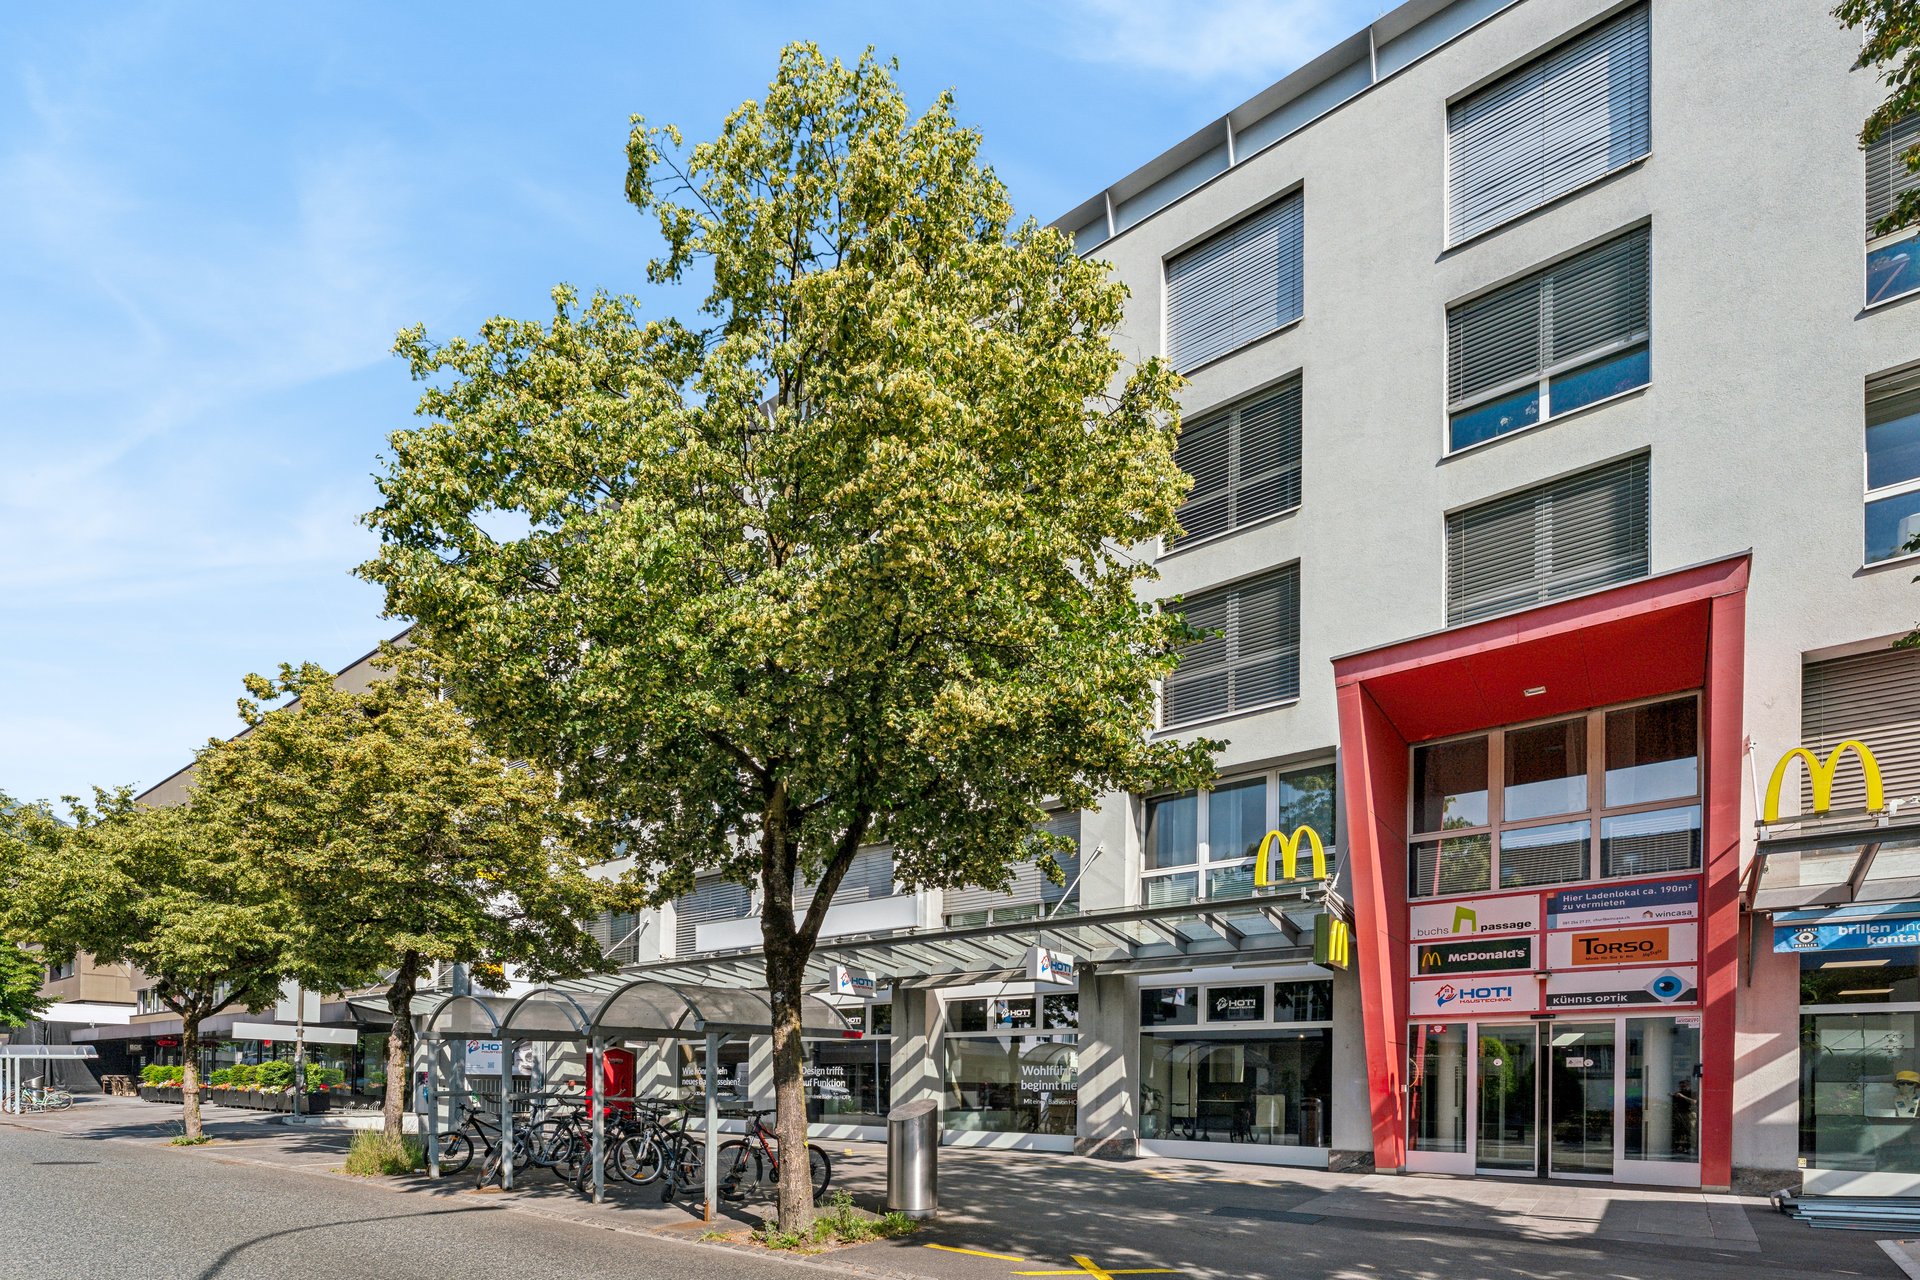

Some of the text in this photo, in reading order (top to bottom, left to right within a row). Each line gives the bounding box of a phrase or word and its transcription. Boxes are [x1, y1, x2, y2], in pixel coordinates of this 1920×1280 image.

[1562, 894, 1583, 902] Hier
[1586, 888, 1640, 900] Ladenlokal
[1642, 887, 1657, 896] ca.
[1562, 900, 1626, 911] zu vermieten
[1655, 909, 1692, 918] wincasa
[1417, 920, 1532, 937] buchs passage
[1838, 922, 1891, 936] brillen
[1867, 932, 1920, 945] konta
[1579, 938, 1654, 955] TORSO
[1050, 961, 1072, 973] HOTI
[851, 977, 874, 986] HOTI
[1459, 986, 1512, 999] HOTI
[802, 1067, 844, 1076] Design trifft
[717, 1078, 740, 1086] ssehen?
[814, 1078, 846, 1087] Funktion
[1021, 1080, 1078, 1092] beginnt hie
